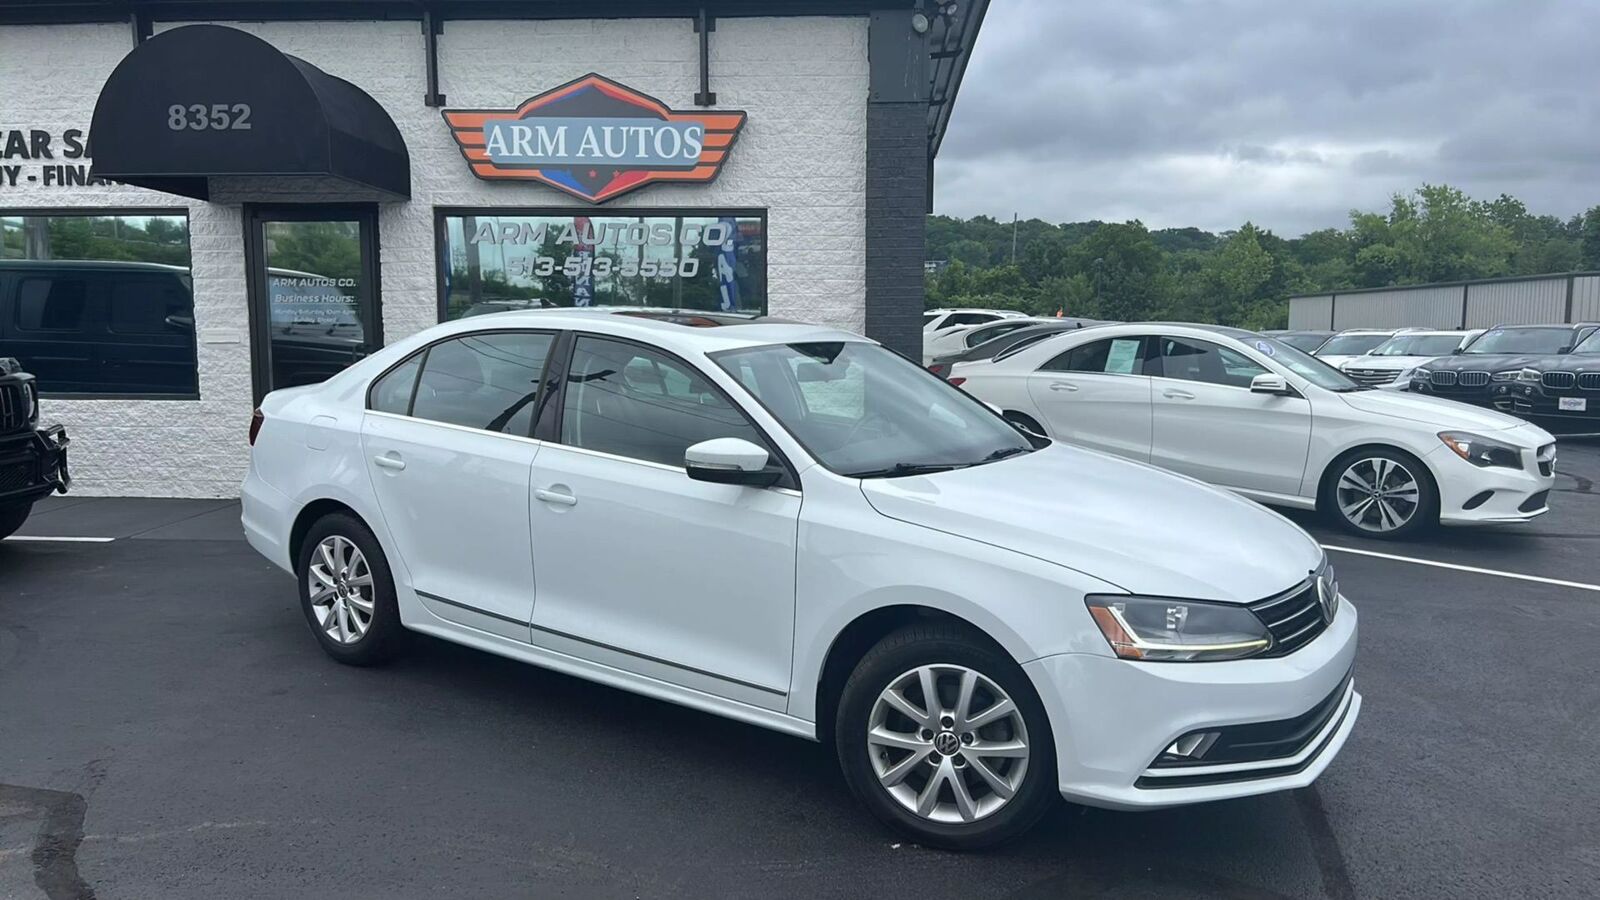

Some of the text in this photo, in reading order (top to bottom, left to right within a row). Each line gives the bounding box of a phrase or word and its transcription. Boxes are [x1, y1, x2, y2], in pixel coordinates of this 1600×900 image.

[168, 104, 251, 130] 8352
[0, 129, 54, 159] AR
[483, 125, 703, 159] ARM AUTOS
[0, 165, 22, 186] Y
[470, 222, 549, 245] ARM
[555, 222, 673, 246] AUTOS
[679, 223, 734, 246] CO.
[507, 256, 700, 278] 513-513-5550
[273, 279, 357, 287] ARM AUTOS CO.
[275, 294, 355, 303] Business Hours:
